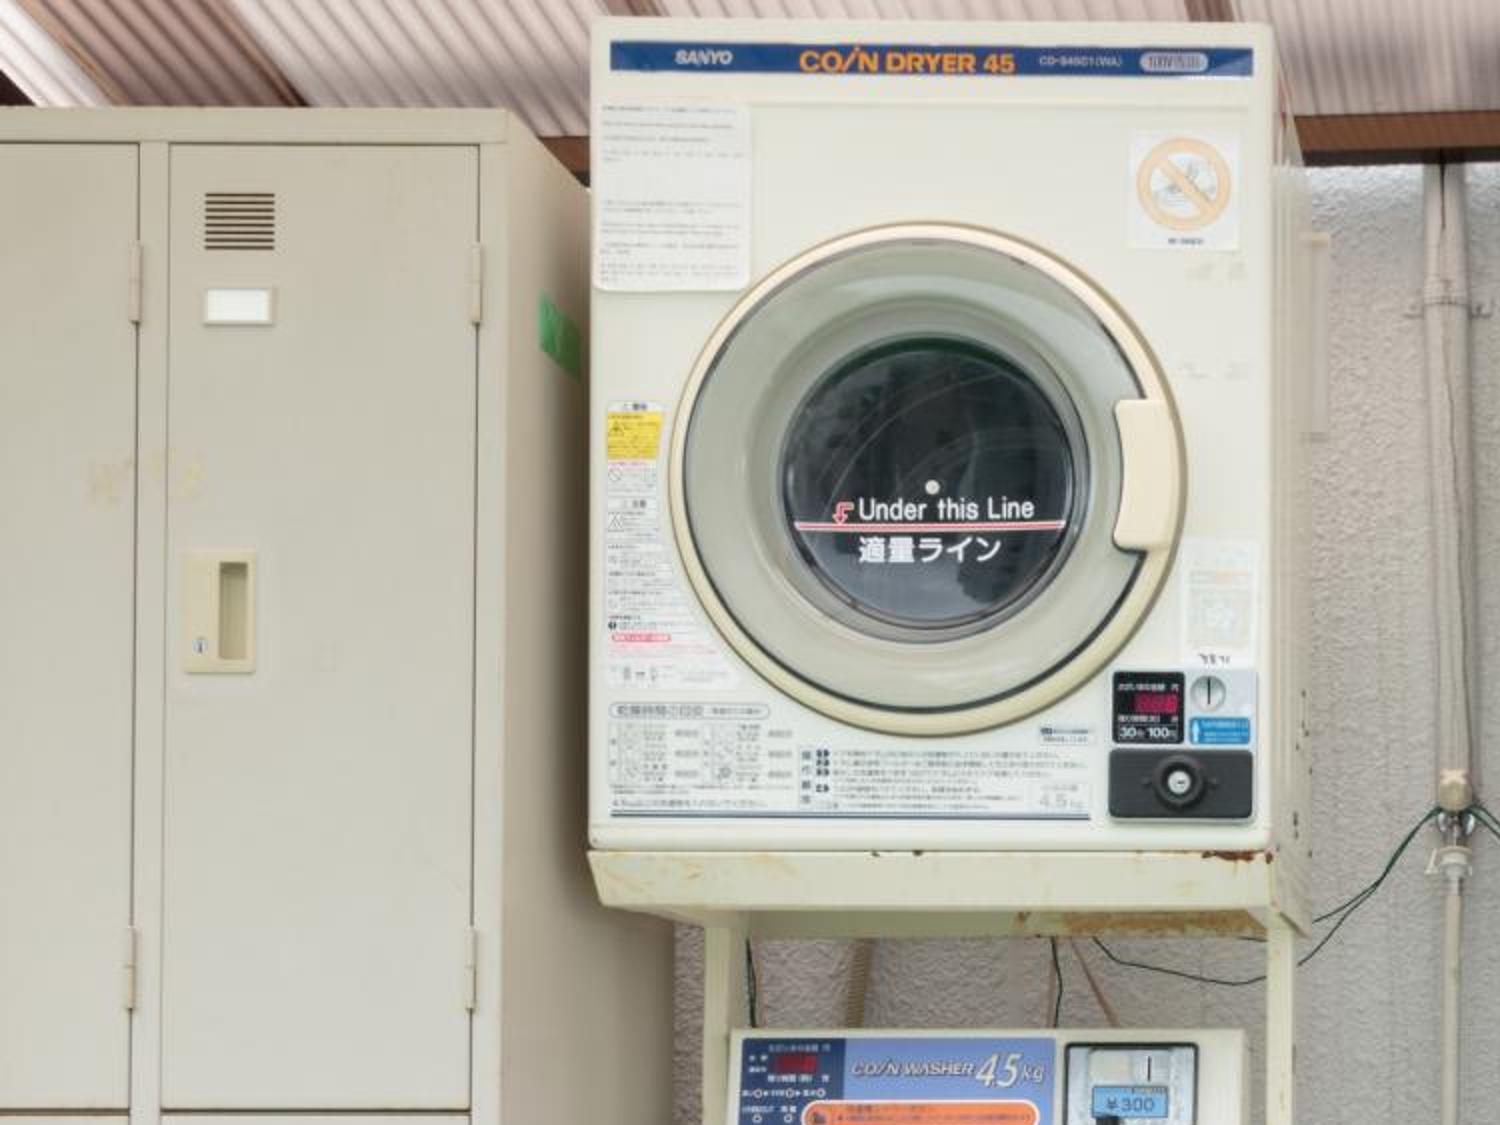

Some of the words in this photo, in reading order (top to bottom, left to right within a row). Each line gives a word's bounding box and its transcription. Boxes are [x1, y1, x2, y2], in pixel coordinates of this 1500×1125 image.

[674, 48, 734, 66] SANYO
[885, 50, 976, 74] DRYER
[983, 52, 1016, 74] 45
[858, 496, 927, 520] Under
[937, 497, 979, 520] this
[987, 495, 1035, 519] Line
[858, 535, 1001, 563] 適量ライン
[904, 1062, 974, 1077] WASHER
[1023, 1064, 1044, 1083] kg
